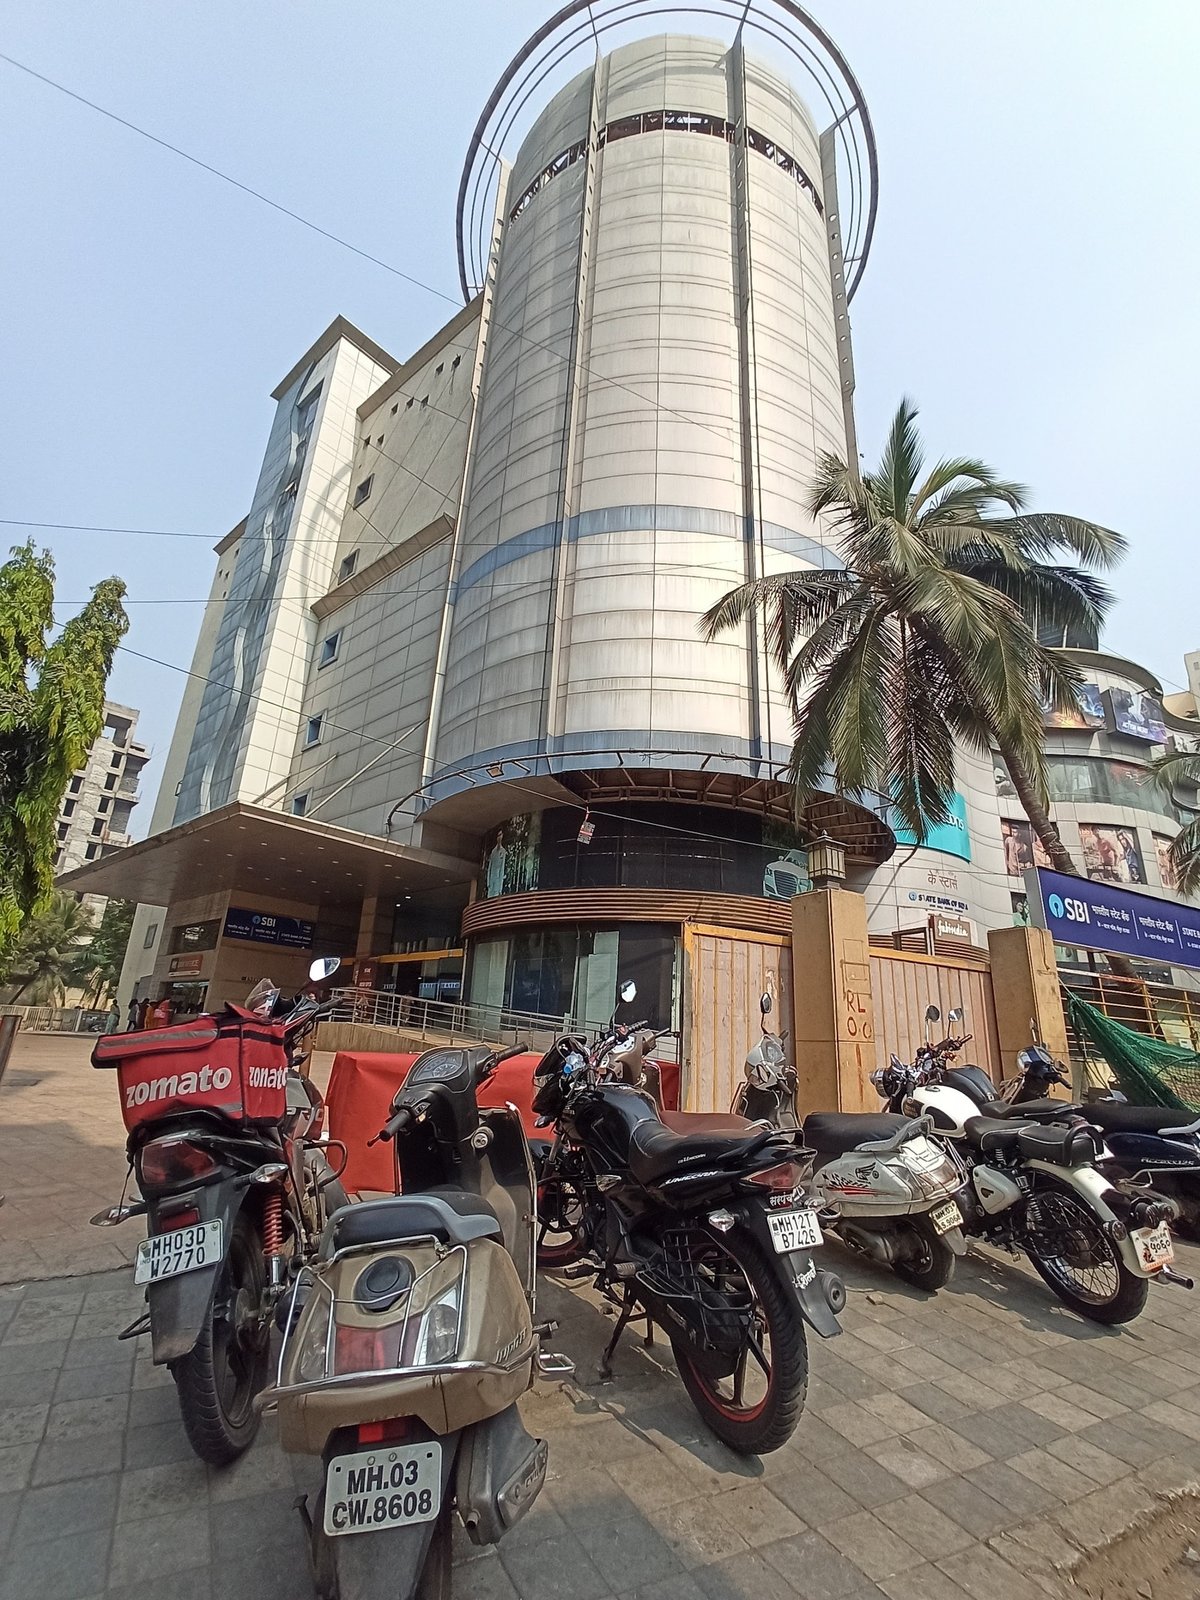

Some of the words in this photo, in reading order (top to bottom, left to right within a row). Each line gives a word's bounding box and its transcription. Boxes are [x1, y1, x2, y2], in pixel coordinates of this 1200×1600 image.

[261, 916, 277, 928] SBI
[1064, 897, 1091, 924] SBI
[126, 1064, 232, 1109] zomato
[777, 1213, 811, 1233] MH12T
[152, 1227, 206, 1258] MH03D
[782, 1229, 816, 1249] B7426
[151, 1247, 205, 1278] W2770
[347, 1460, 418, 1495] MH.03
[332, 1489, 432, 1529] CW.8608
